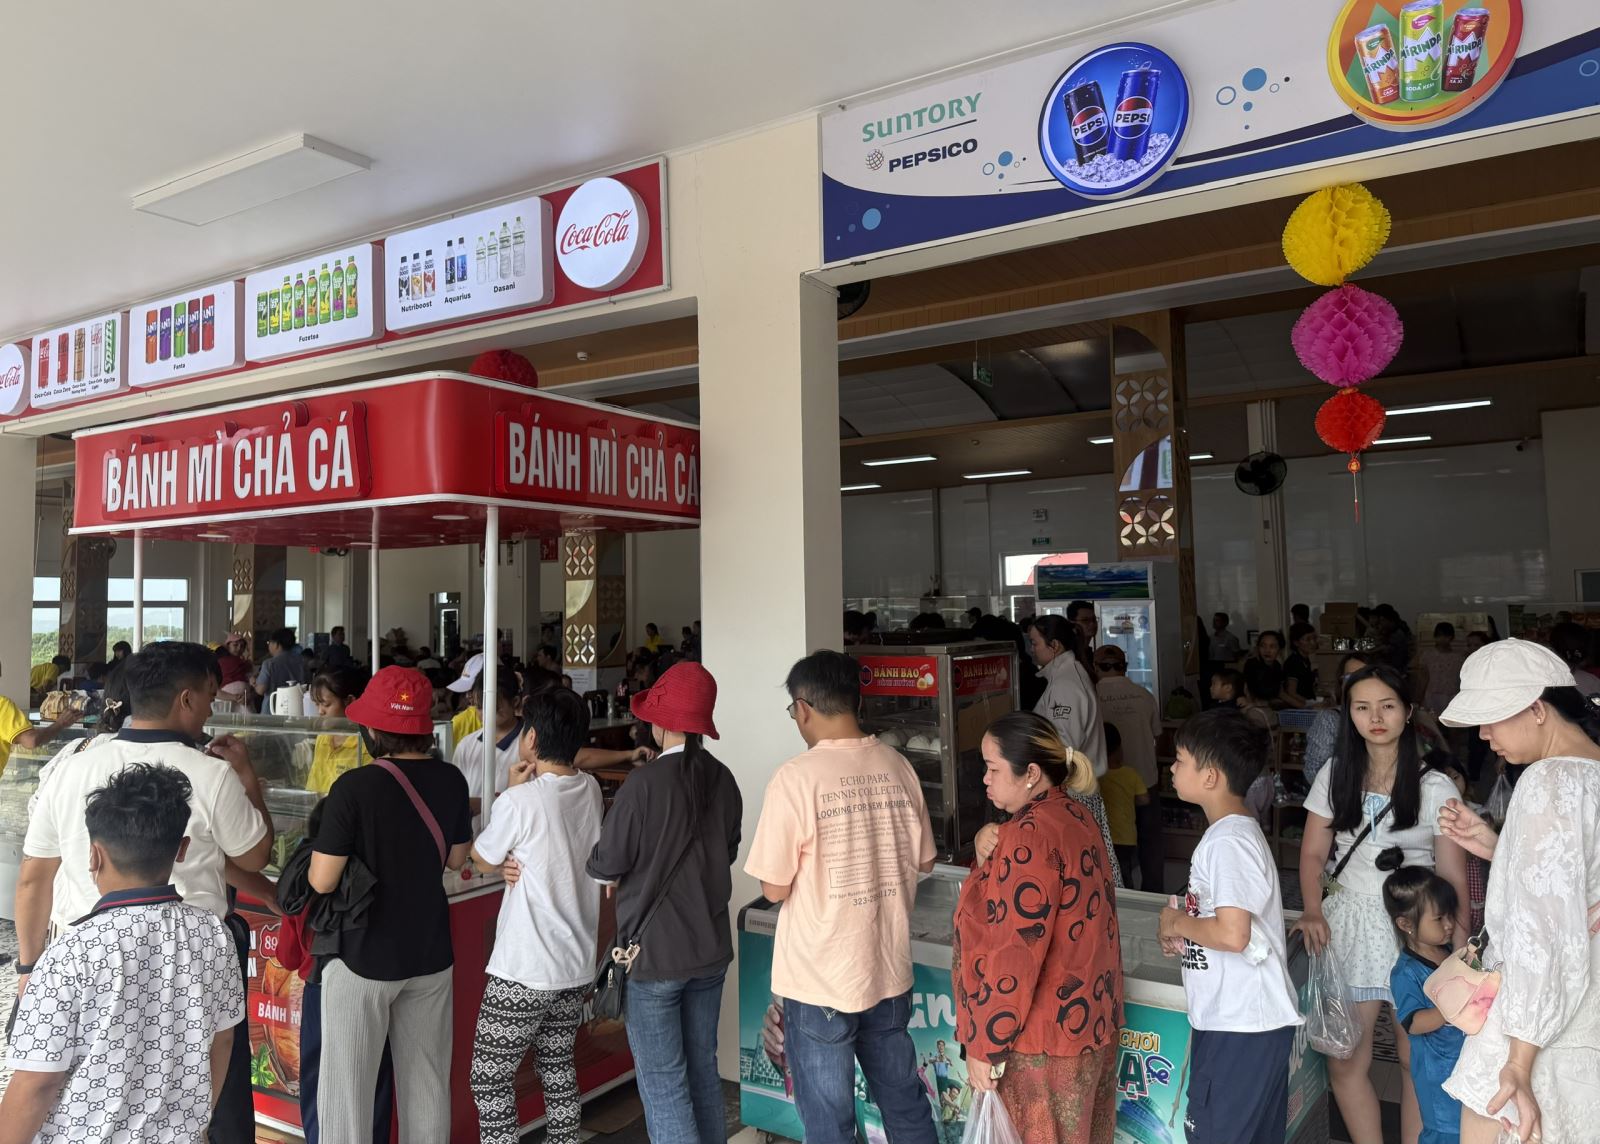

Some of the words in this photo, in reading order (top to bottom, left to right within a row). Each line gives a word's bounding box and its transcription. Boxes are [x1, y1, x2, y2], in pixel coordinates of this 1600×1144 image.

[1074, 116, 1106, 136] PEPSI
[1116, 113, 1150, 123] PEPSI
[888, 138, 978, 173] PEPSICO
[560, 208, 633, 255] Coca-Cola
[493, 282, 516, 293] Dasani
[401, 300, 432, 312] Nutriboost
[444, 292, 472, 304] Aquarius
[106, 444, 178, 512] BÁNH
[187, 430, 222, 504] MÌ
[233, 412, 296, 500] CHẢ
[308, 411, 354, 492] CÁ
[509, 413, 581, 492] BÁNH
[589, 428, 618, 496] MÌ
[626, 431, 668, 502] CHẢ
[674, 444, 700, 506] CÁ
[900, 667, 920, 678] BAO
[840, 776, 865, 787] ECHO
[867, 773, 891, 784] PARK
[820, 788, 856, 804] TENNIS
[858, 785, 909, 798] COLLECTIV
[816, 806, 851, 820] LOOKING
[853, 803, 867, 812] FOR
[258, 1000, 287, 1023] BÁNH
